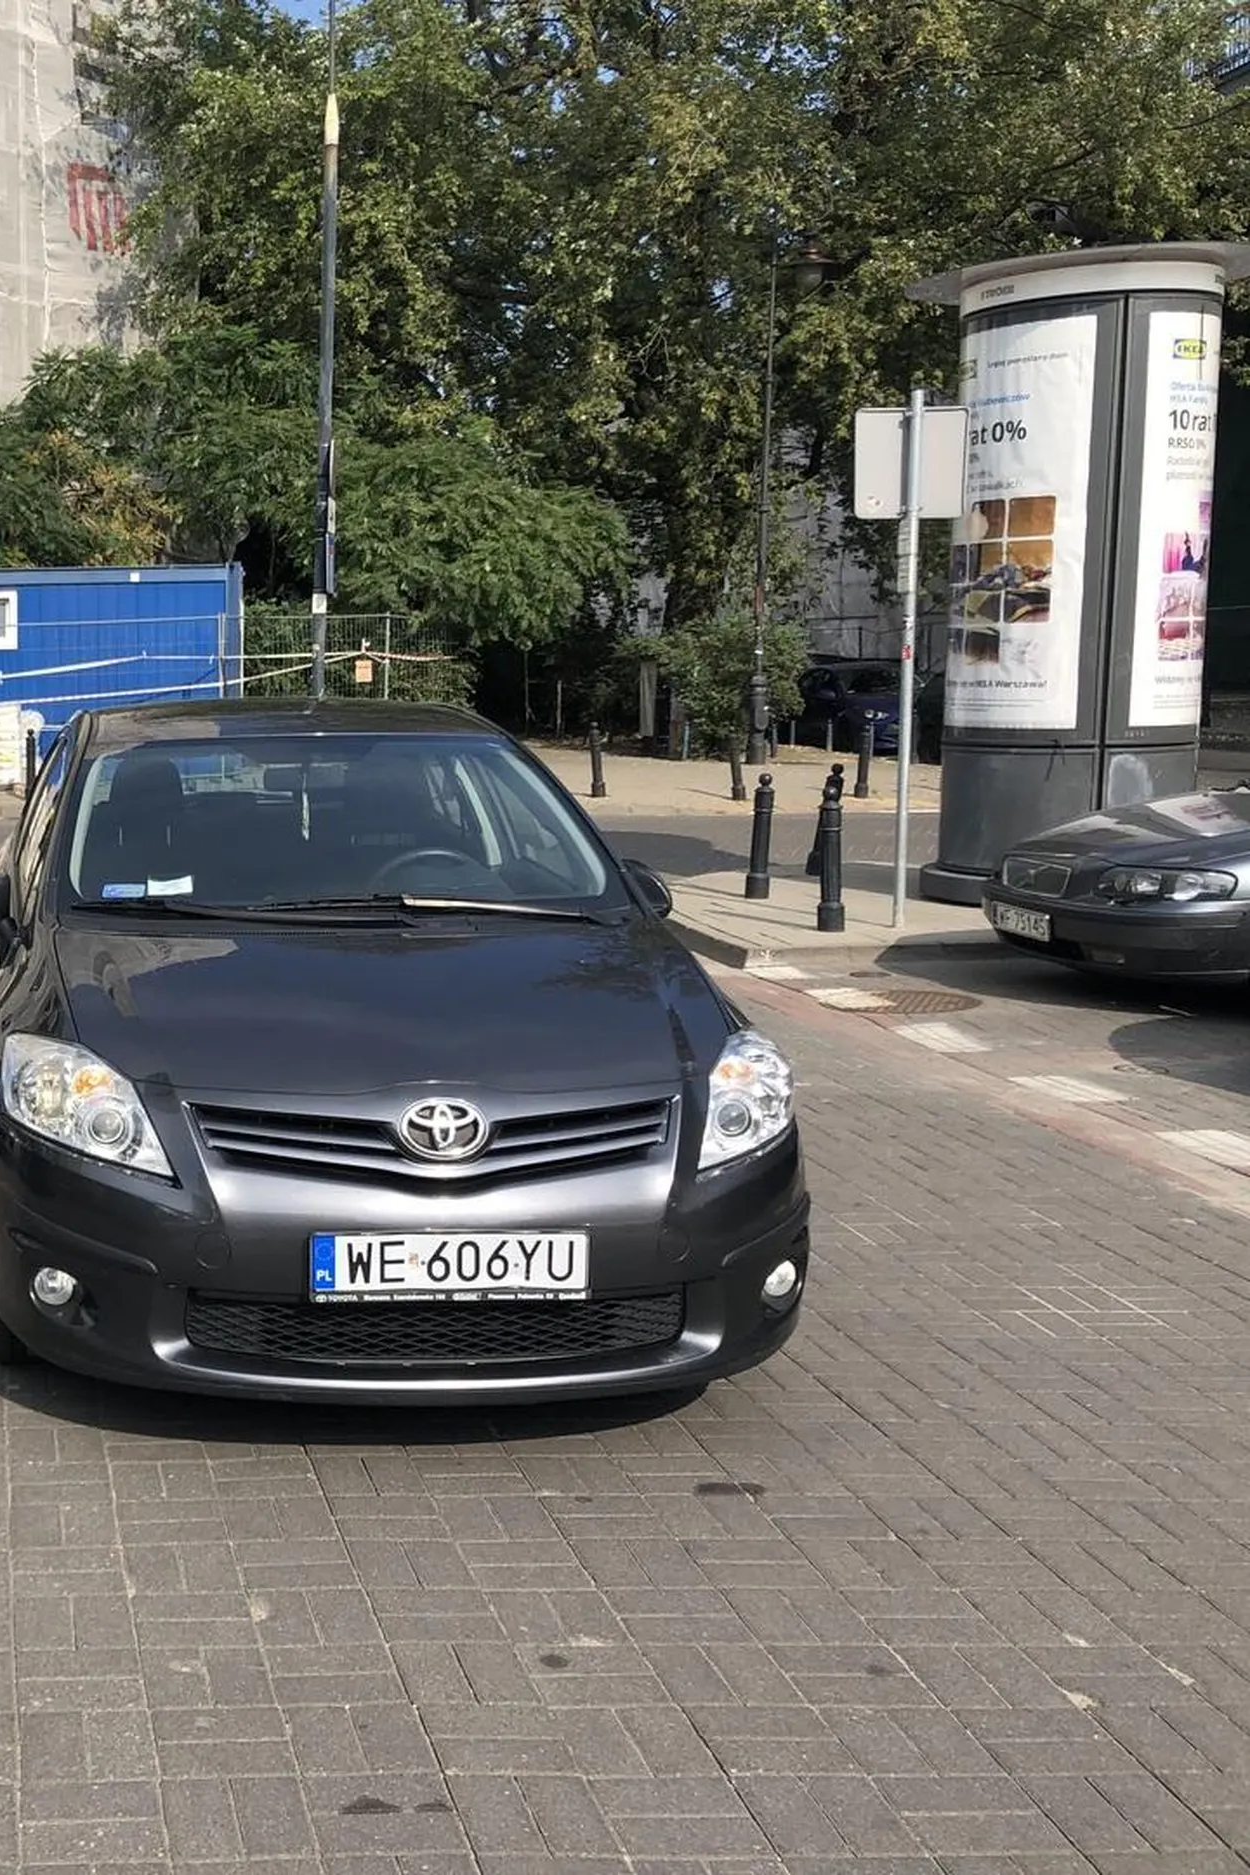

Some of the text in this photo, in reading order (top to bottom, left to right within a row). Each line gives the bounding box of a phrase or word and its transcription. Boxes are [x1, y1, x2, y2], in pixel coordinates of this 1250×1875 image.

[1168, 409, 1190, 431] 10
[969, 419, 1027, 446] at 0%
[347, 1239, 575, 1284] WE 606YU
[316, 1270, 332, 1282] PL
